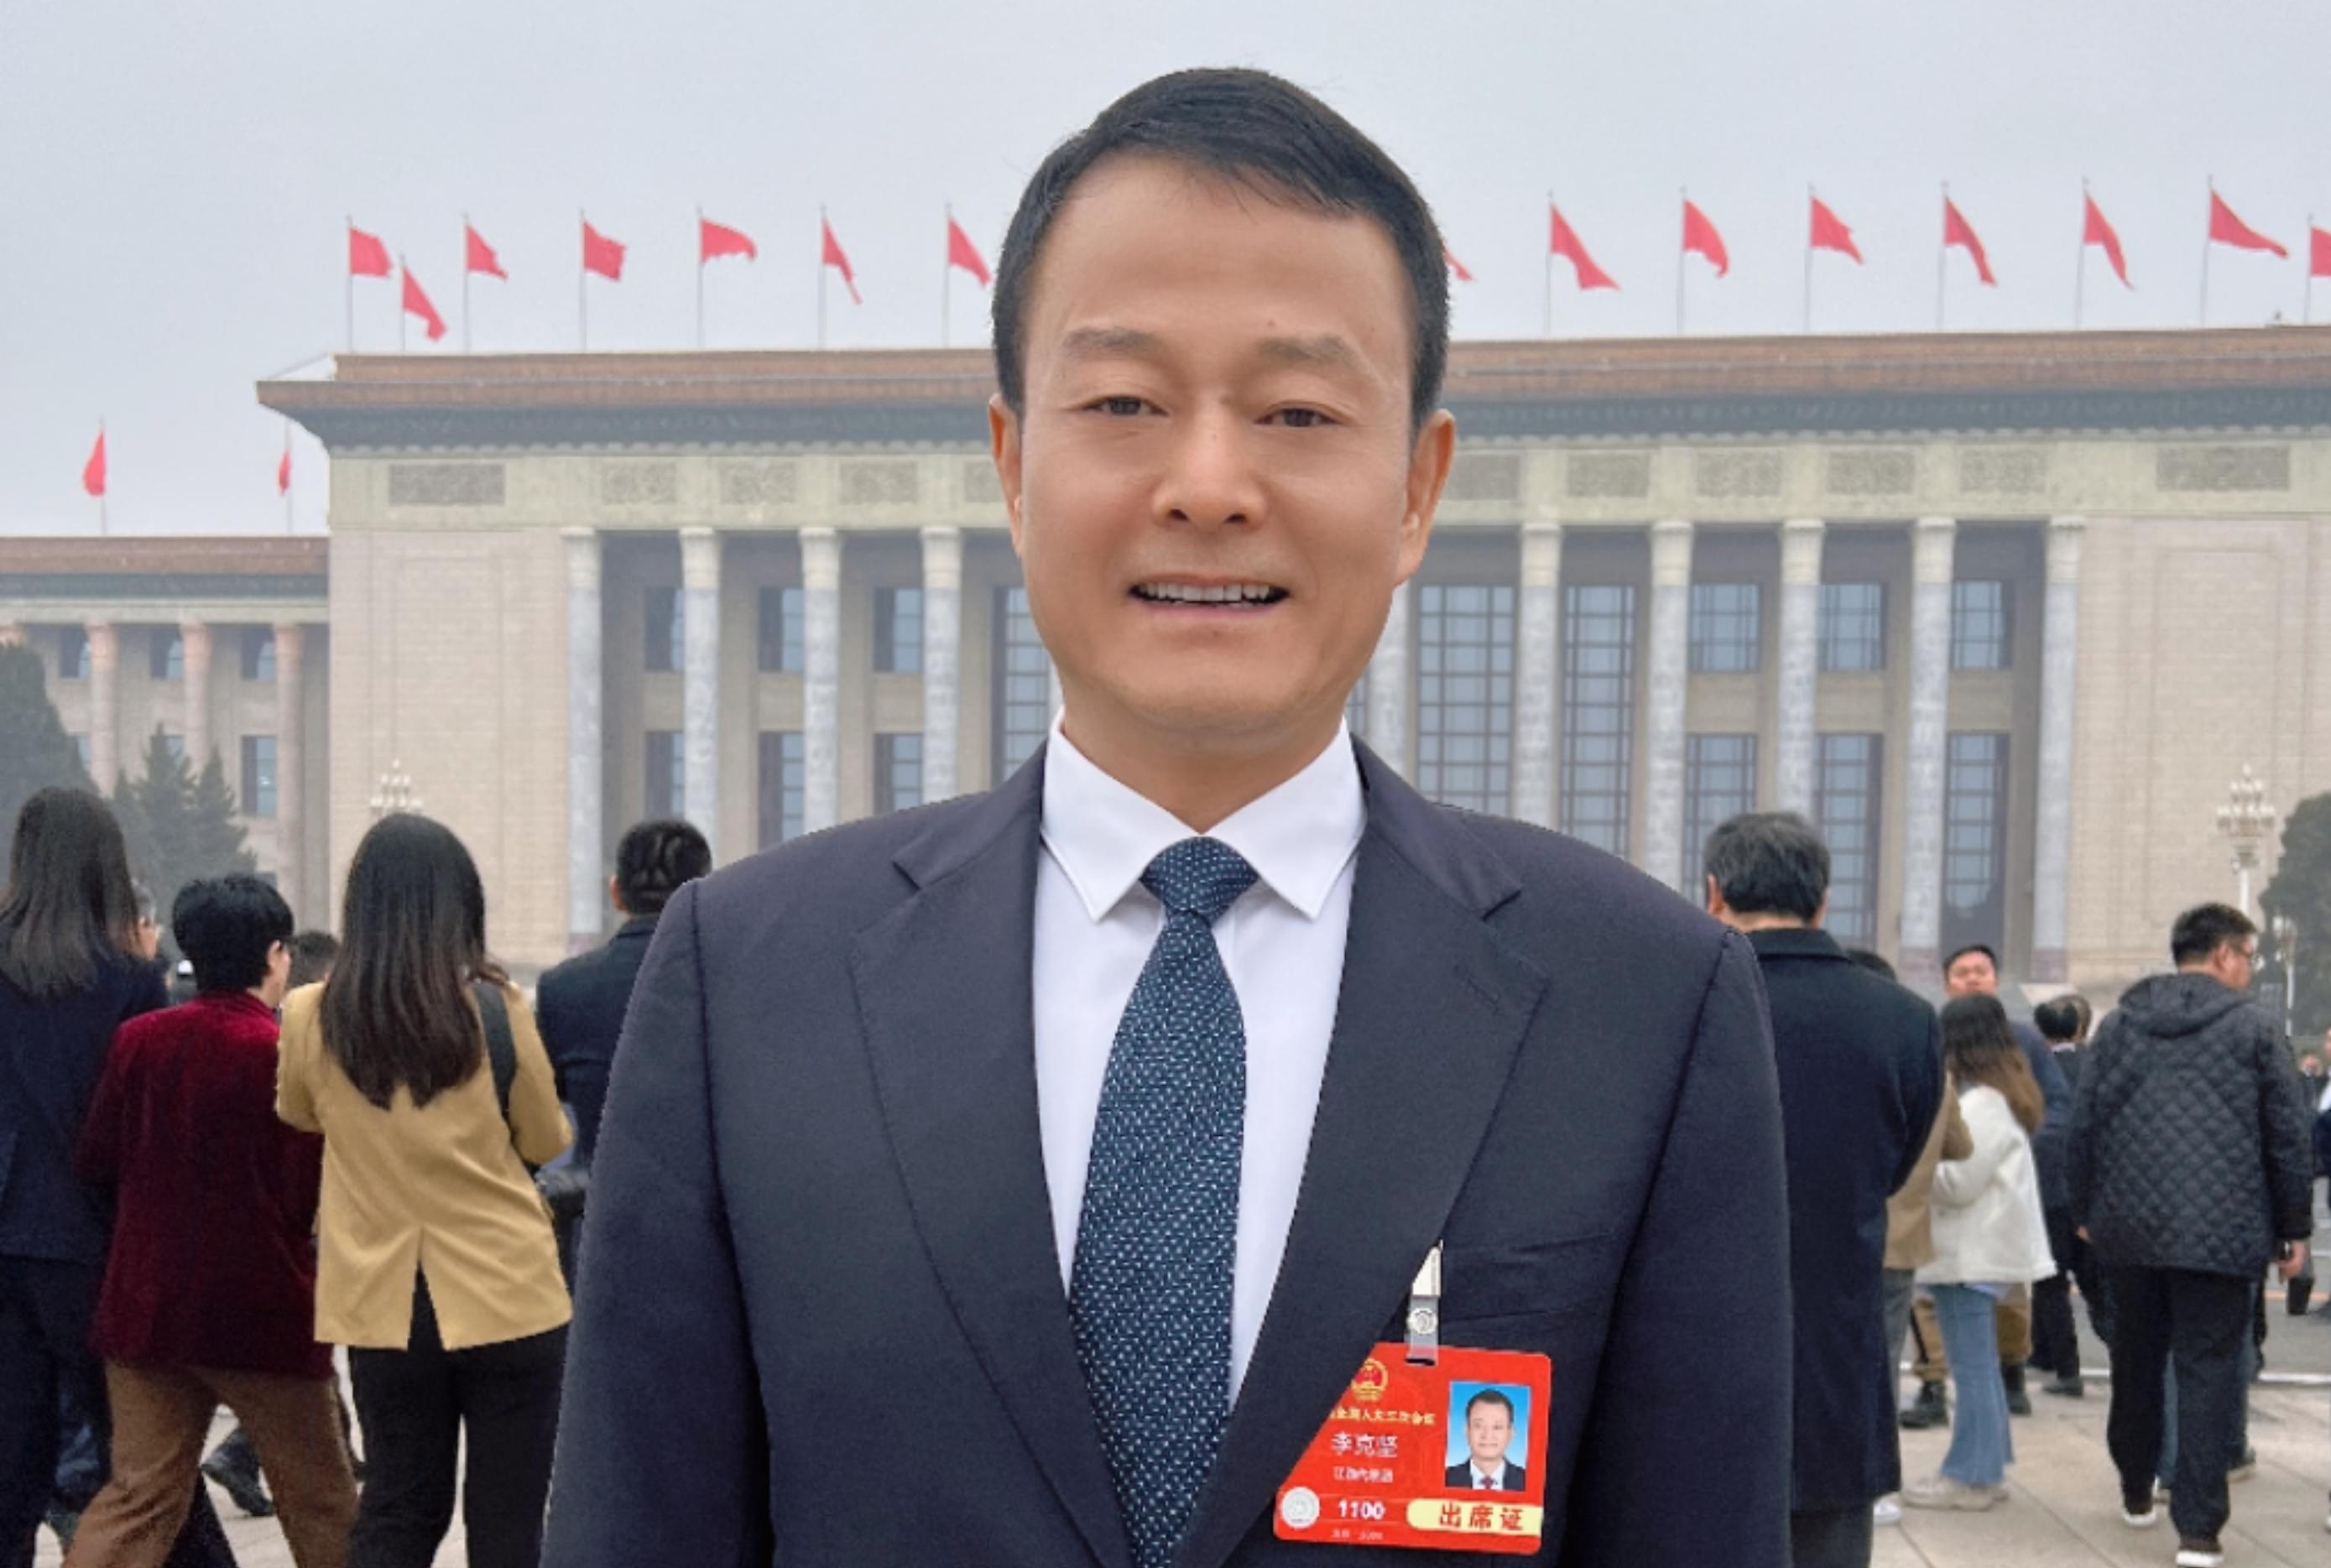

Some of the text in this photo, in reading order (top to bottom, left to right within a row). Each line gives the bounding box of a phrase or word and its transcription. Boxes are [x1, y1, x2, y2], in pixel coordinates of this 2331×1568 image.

[1338, 1499, 1385, 1520] 1100
[1439, 1503, 1523, 1531] 出席证
